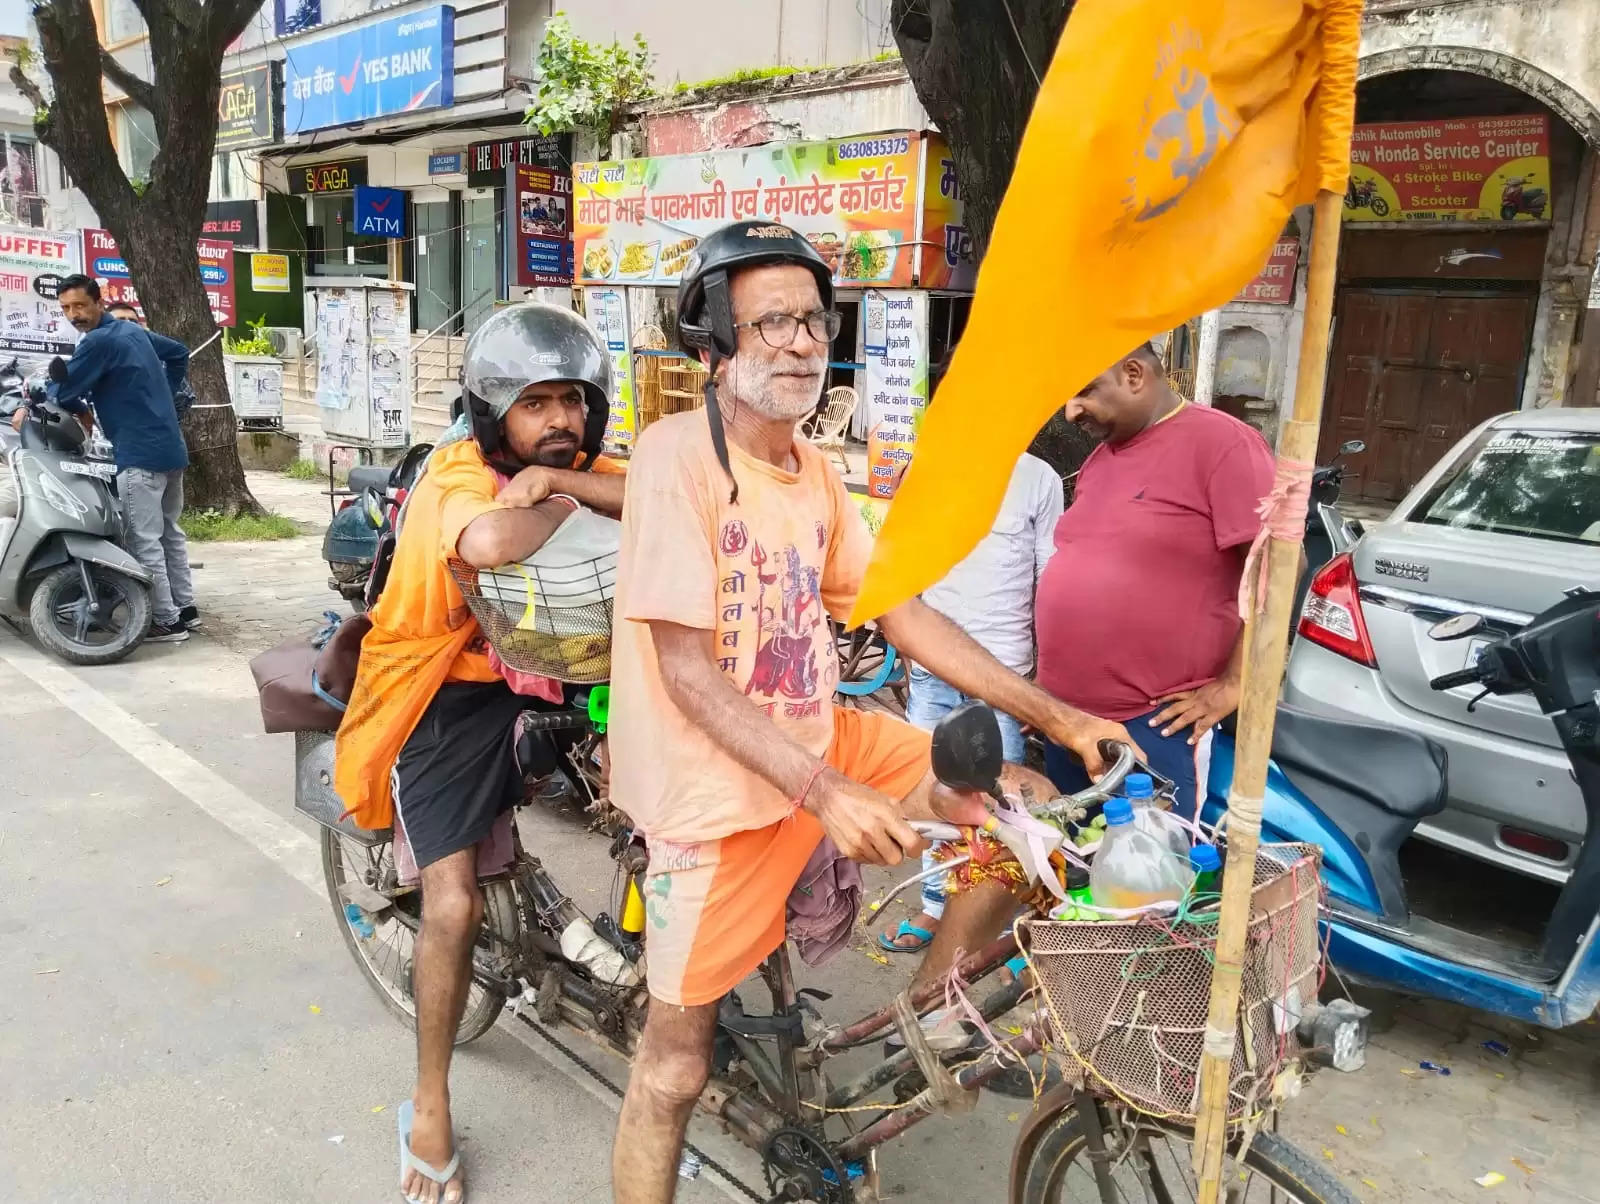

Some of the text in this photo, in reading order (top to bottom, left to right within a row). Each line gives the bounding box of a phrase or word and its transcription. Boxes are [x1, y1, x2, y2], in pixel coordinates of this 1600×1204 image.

[363, 45, 432, 84] YES BANK
[313, 65, 336, 96] बैंक
[1379, 125, 1441, 141] Automobile
[838, 137, 909, 160] 8630835375
[1351, 139, 1539, 163] ew Honda Service Center
[1404, 171, 1449, 184] Stroke
[1452, 170, 1483, 182] Bike
[579, 189, 611, 224] मोटा
[615, 186, 647, 226] भाई
[650, 179, 728, 221] पावभाजी
[731, 178, 760, 220] एवं
[839, 165, 907, 214] कॉर्नर
[1434, 184, 1442, 193] &
[1411, 195, 1468, 207] Scooter
[362, 217, 400, 234] ATM
[0, 235, 68, 259] UFFET
[92, 233, 116, 249] The
[887, 296, 913, 310] वभाजी
[911, 397, 925, 407] चाट
[1375, 567, 1429, 582] SUZUKI
